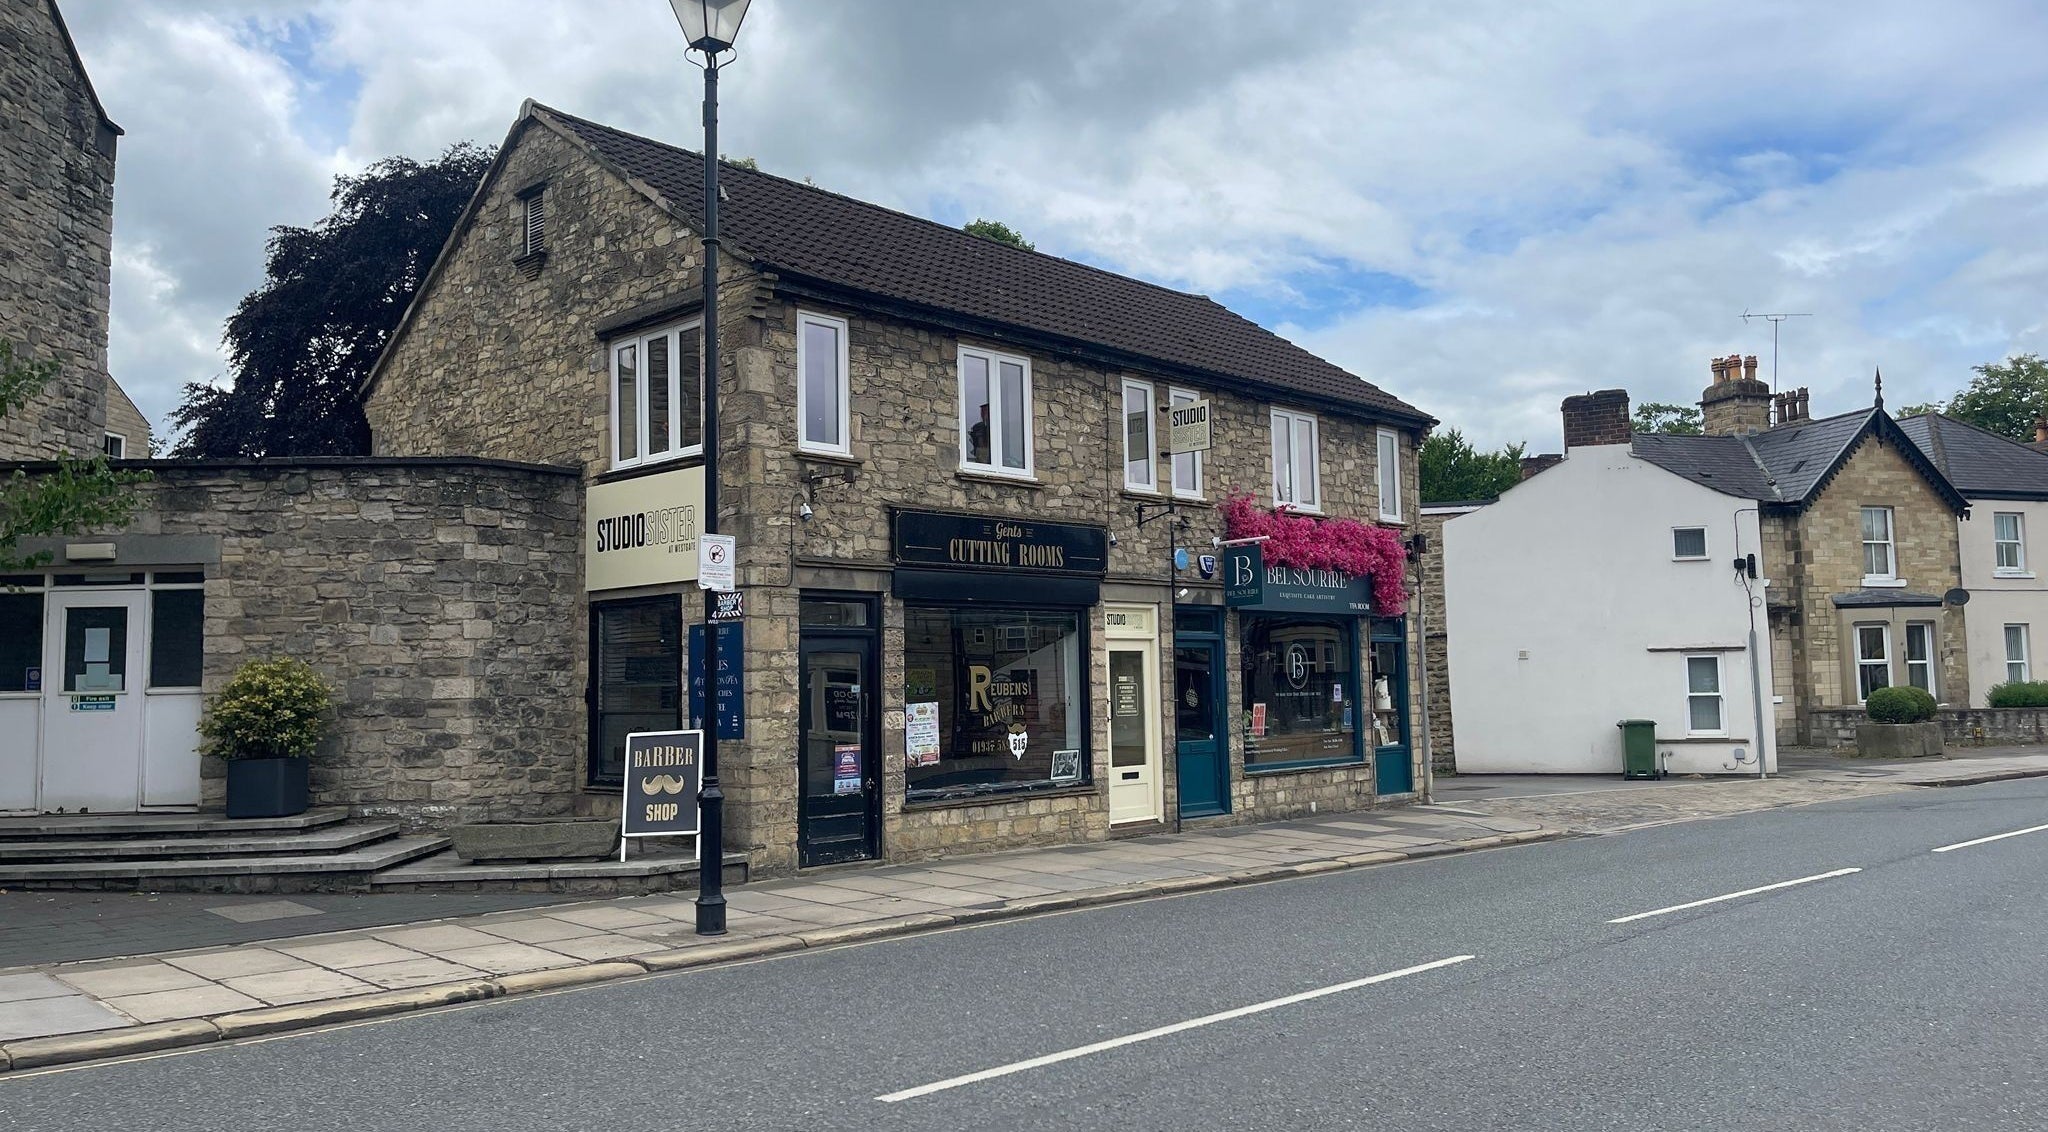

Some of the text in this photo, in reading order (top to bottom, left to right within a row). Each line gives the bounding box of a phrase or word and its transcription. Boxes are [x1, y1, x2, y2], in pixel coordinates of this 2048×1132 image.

[1173, 406, 1206, 427] STUDIO
[995, 522, 1022, 539] Gents
[949, 538, 1064, 567] CUTTING ROOMS
[1234, 555, 1253, 586] B
[1267, 566, 1347, 589] BEL SOURIRE
[1292, 652, 1304, 679] B
[1012, 738, 1026, 751] 515
[634, 745, 693, 768] BARBER
[646, 803, 678, 822] SHOP
